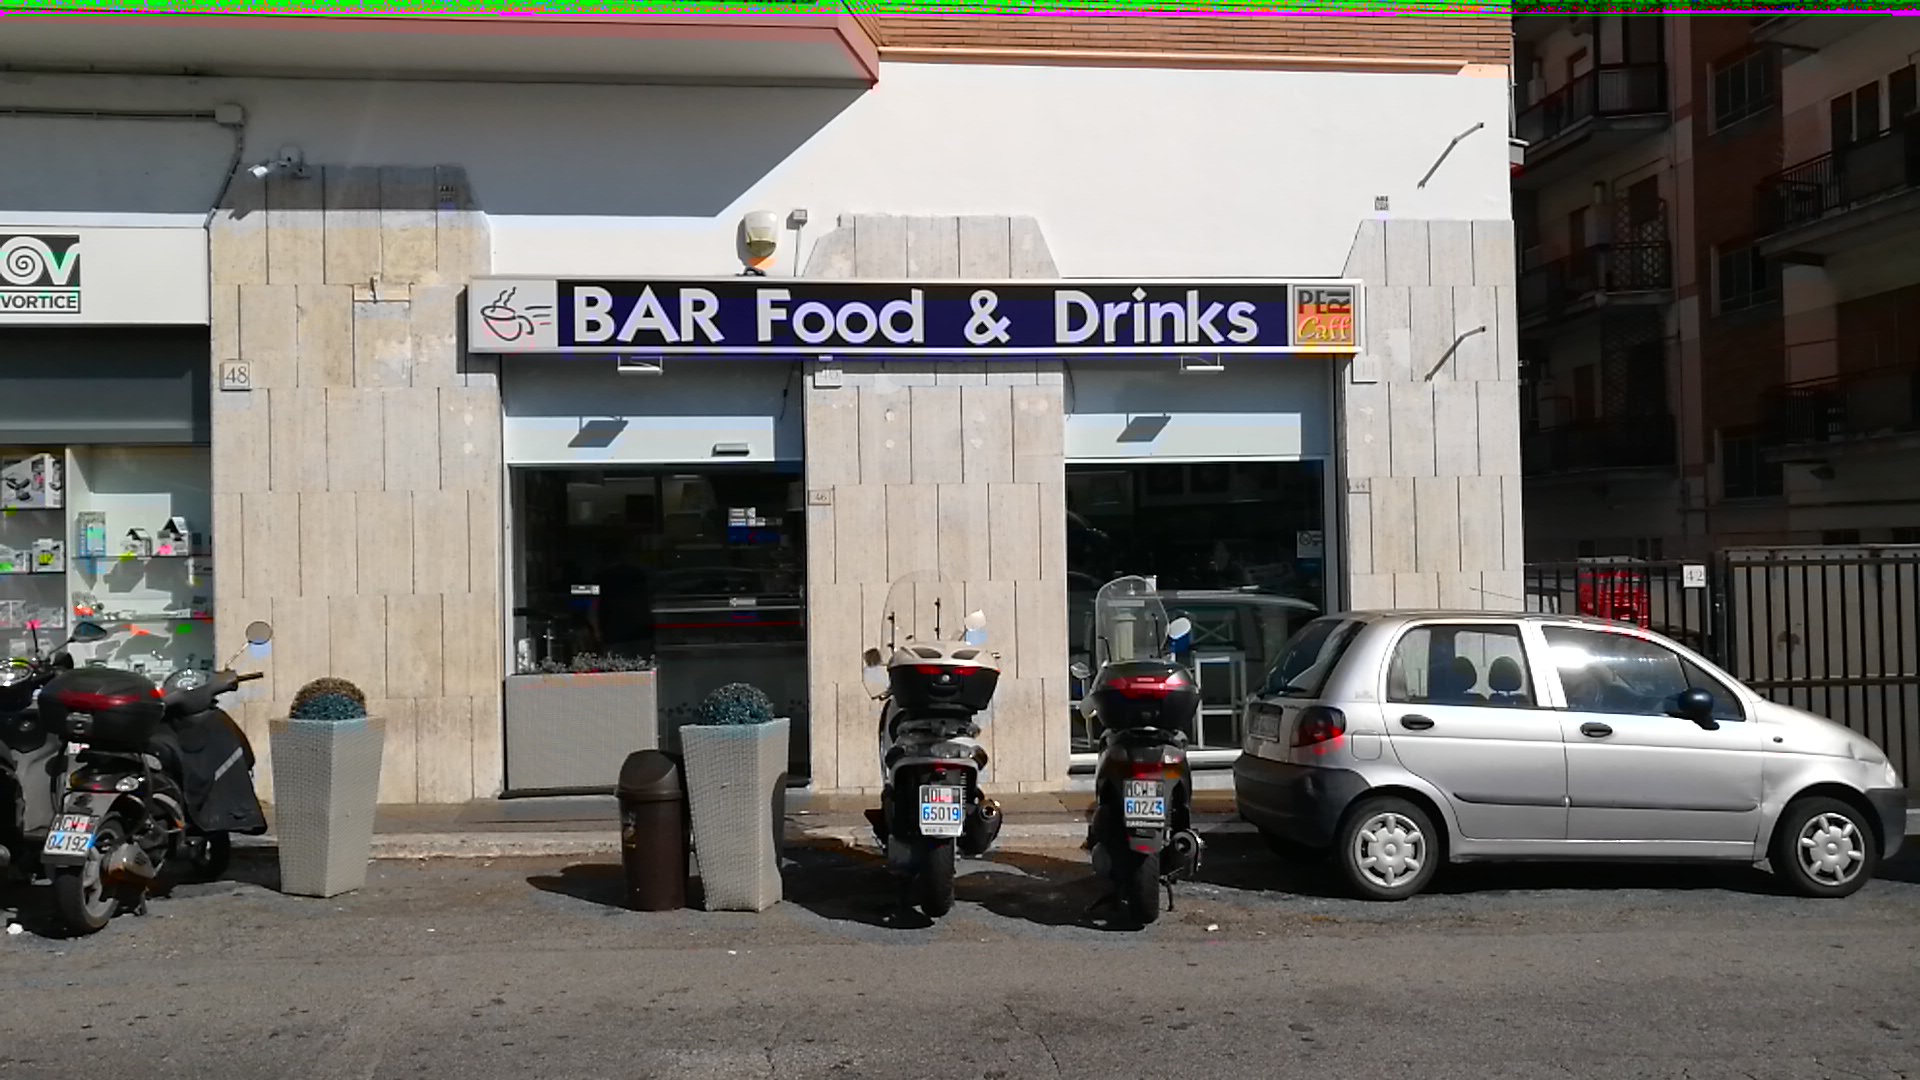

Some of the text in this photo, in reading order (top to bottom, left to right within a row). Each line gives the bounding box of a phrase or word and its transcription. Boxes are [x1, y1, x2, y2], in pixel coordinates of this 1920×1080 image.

[0, 295, 77, 309] VORTICE
[573, 285, 1259, 345] BAR Food & Drinks
[225, 366, 247, 384] 48
[1686, 570, 1704, 582] 42
[923, 806, 959, 821] 65019
[1126, 800, 1163, 816] 60243
[46, 834, 90, 852] 04192
